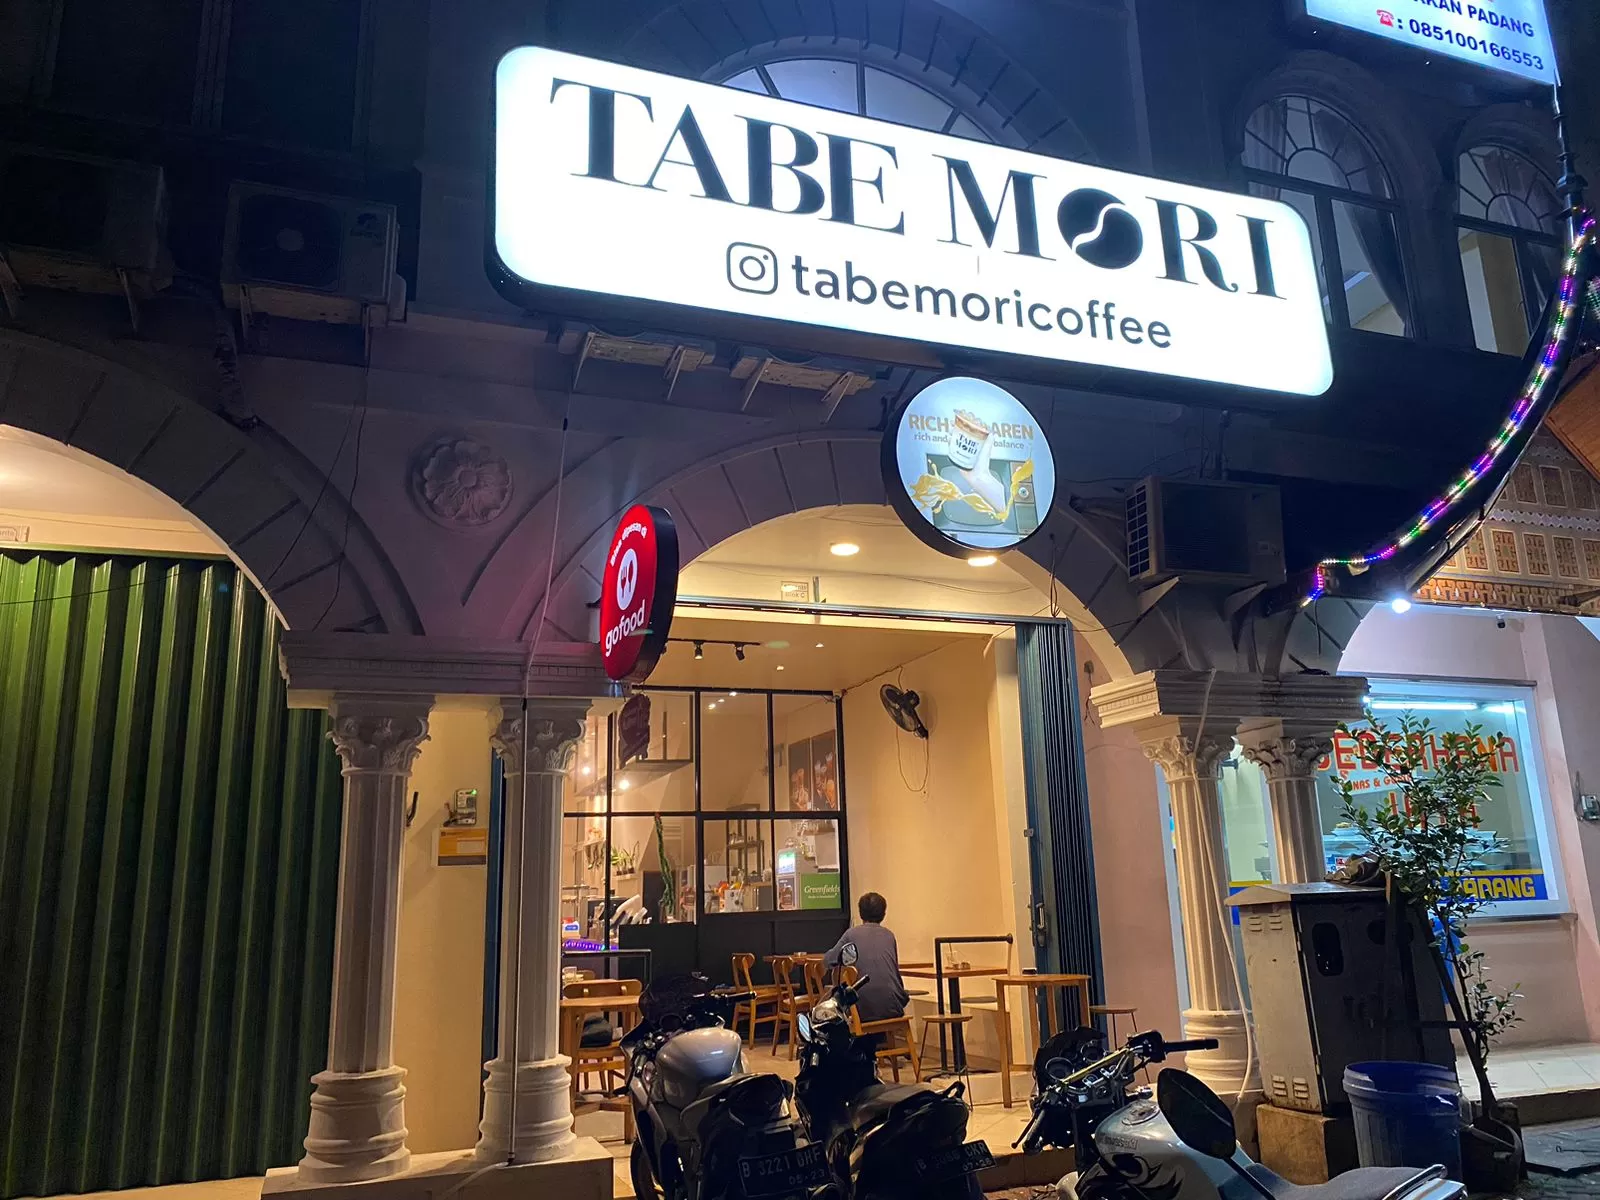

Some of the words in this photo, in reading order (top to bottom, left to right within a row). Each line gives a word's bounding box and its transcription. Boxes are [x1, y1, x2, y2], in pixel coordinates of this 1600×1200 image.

[1413, 0, 1463, 16] KAN
[1467, 4, 1535, 38] PADANG
[1409, 18, 1545, 71] 085100166553
[549, 77, 905, 236] TABE
[931, 153, 1288, 301] MORI
[791, 255, 1172, 348] tabemoricoffee
[908, 413, 949, 433] RICH
[991, 422, 1034, 441] AREN
[913, 431, 931, 441] rich
[993, 439, 1025, 450] balance
[605, 599, 645, 657] gofood
[741, 1161, 752, 1179] B
